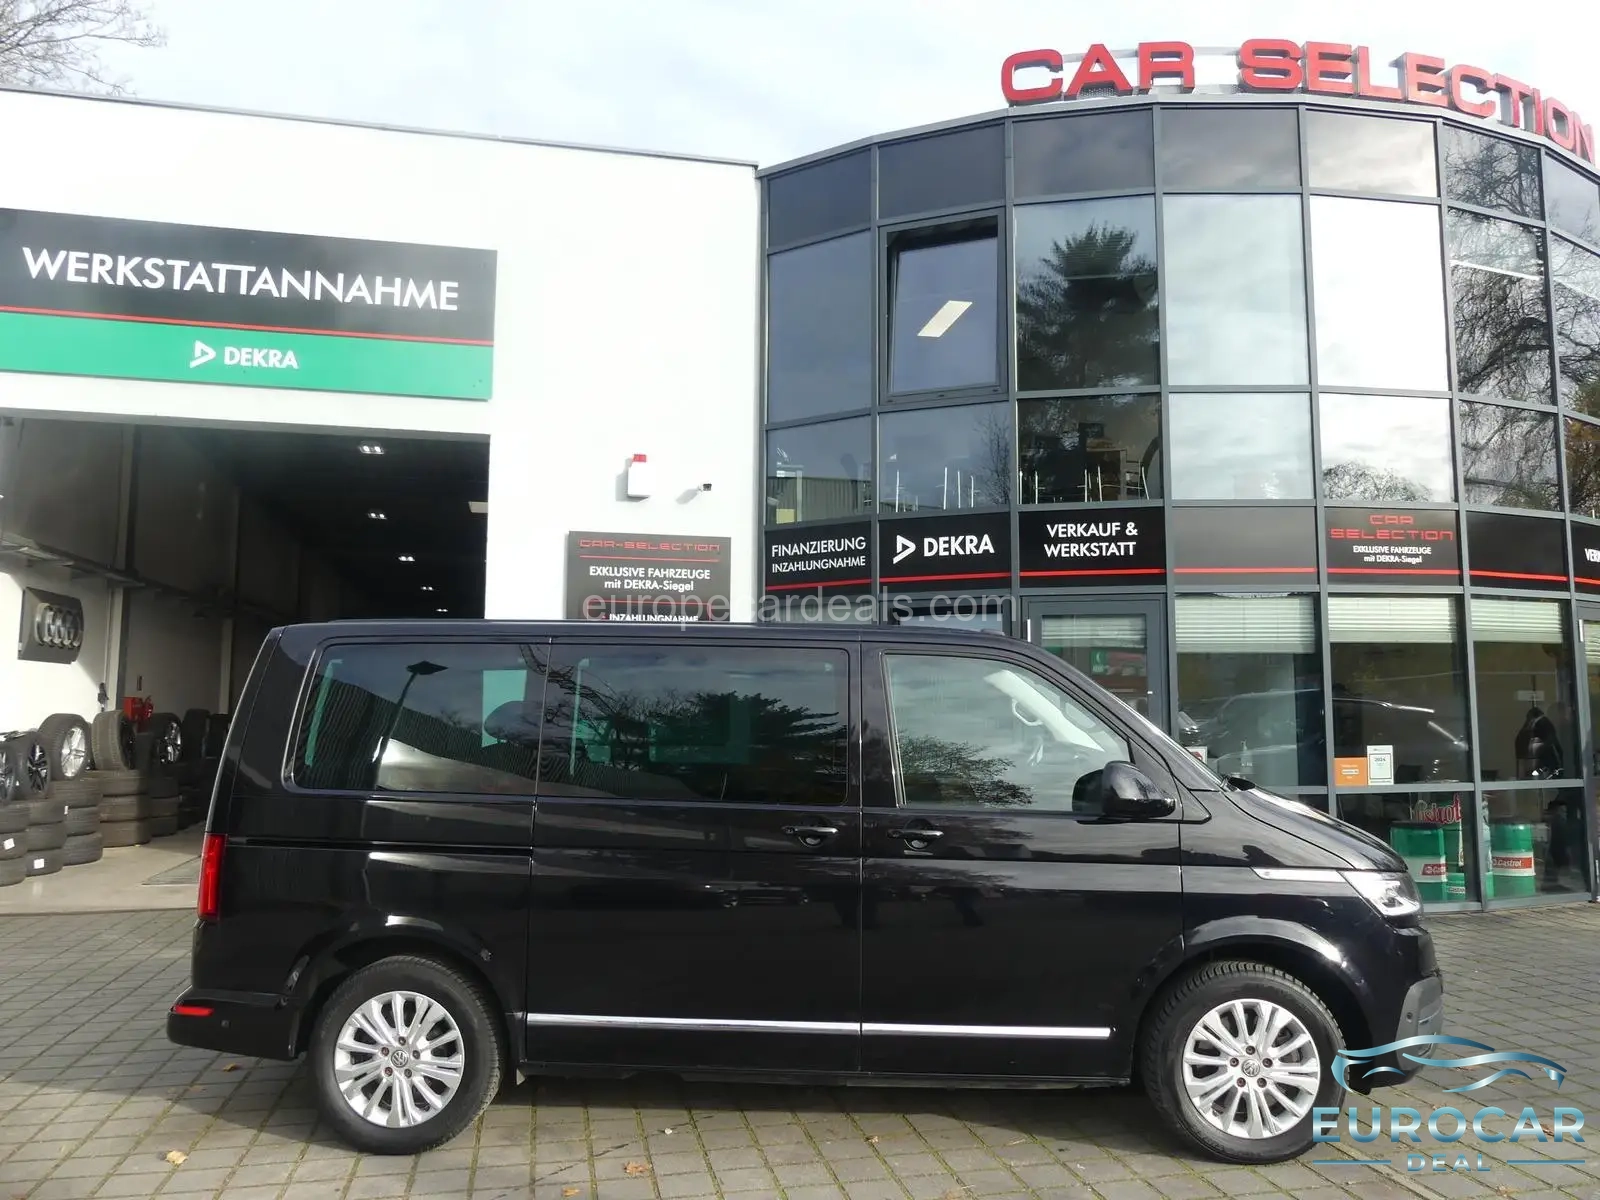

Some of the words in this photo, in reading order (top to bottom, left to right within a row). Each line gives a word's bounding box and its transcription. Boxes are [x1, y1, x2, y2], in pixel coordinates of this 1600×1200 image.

[1000, 41, 1195, 107] CAR
[1236, 37, 1596, 167] SELECTION
[22, 246, 460, 312] WERKSTATTANNAHME
[223, 345, 299, 369] DEKRA
[1369, 514, 1414, 525] CAR
[1046, 522, 1122, 538] VERKAUF
[1125, 521, 1139, 536] &
[1329, 527, 1454, 541] SELECTION
[579, 538, 721, 552] CAR-SELECTION
[771, 536, 867, 558] FINANZIERUNG
[922, 534, 995, 557] DEKRA
[1043, 541, 1137, 558] WERKSTATT
[1352, 545, 1389, 554] EXKLUSIVE
[1390, 546, 1432, 555] FAHRZEUGE
[771, 555, 867, 573] INZAHLUNGNAHME
[1363, 554, 1375, 562] mit
[1376, 554, 1423, 565] DEKRA-Siegel
[589, 566, 645, 578] EXKLUSIVE
[647, 567, 711, 580] FAHRZEUGE
[604, 579, 622, 589] mit
[623, 579, 694, 593] DEKRA-Siegel
